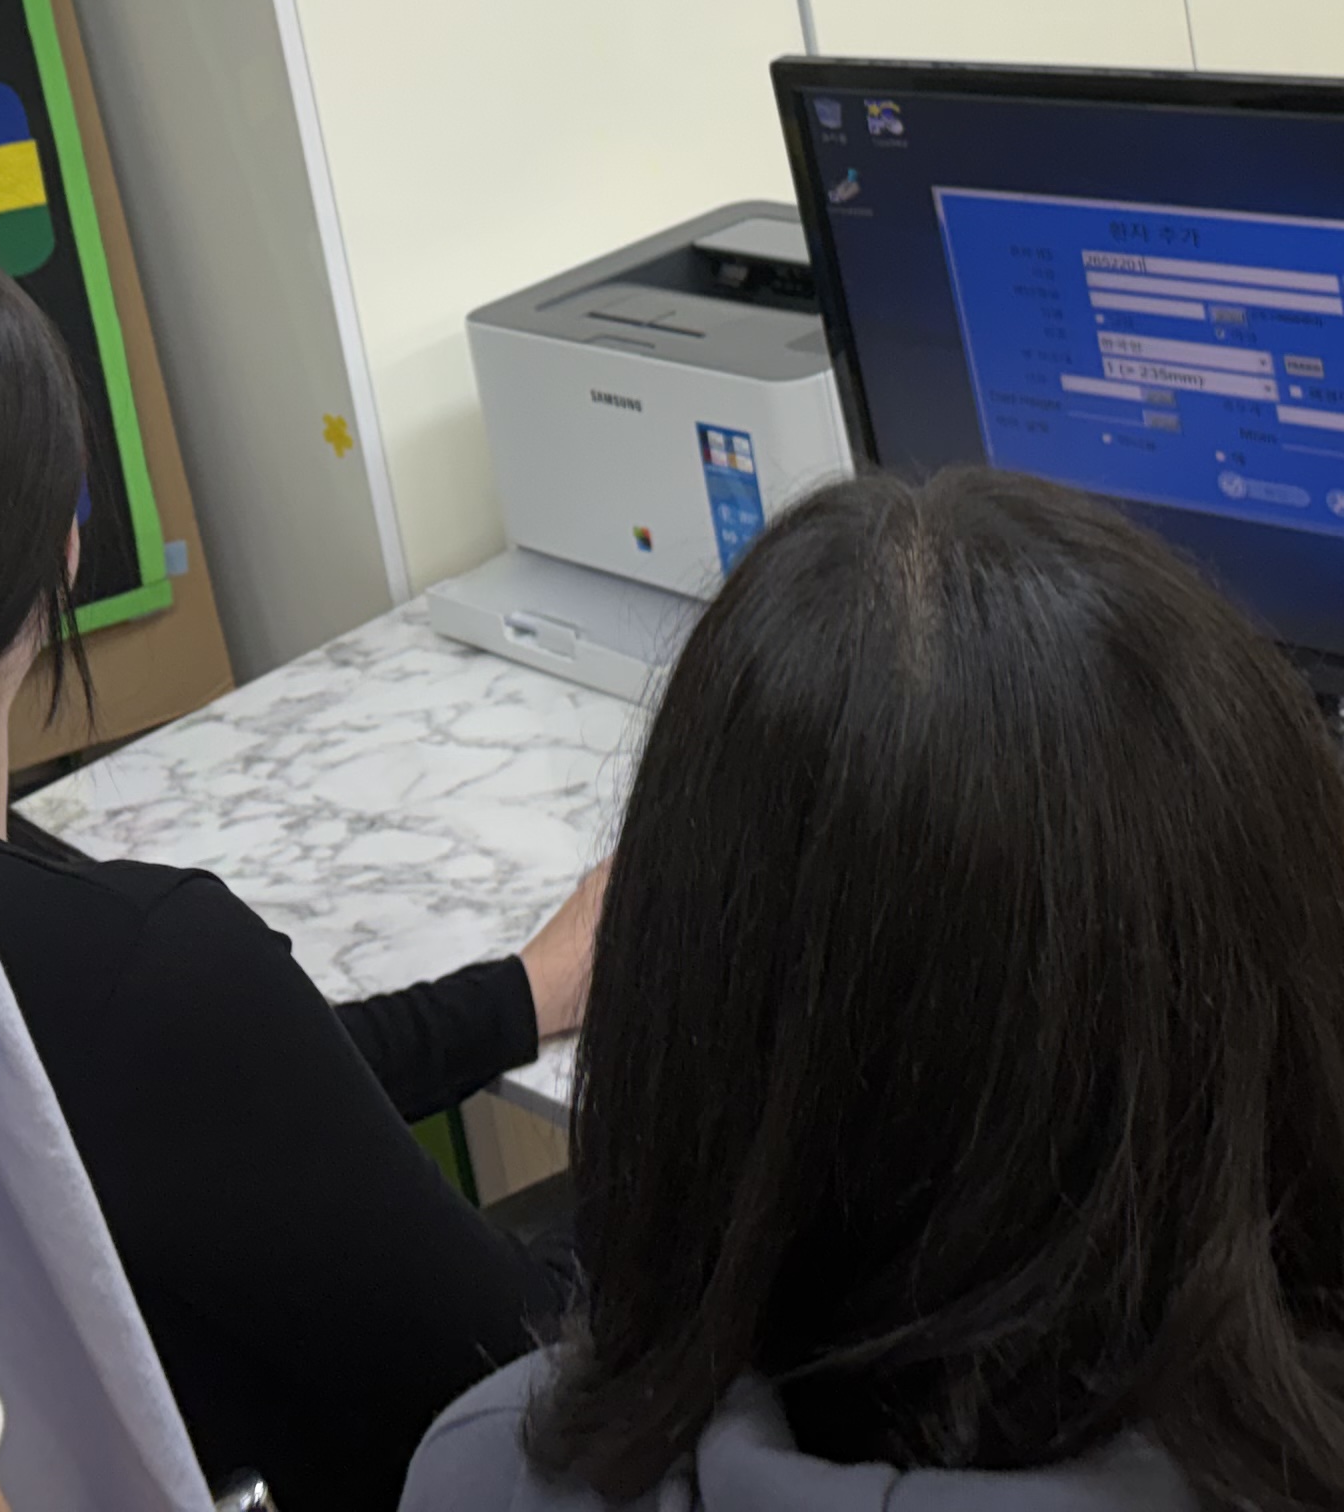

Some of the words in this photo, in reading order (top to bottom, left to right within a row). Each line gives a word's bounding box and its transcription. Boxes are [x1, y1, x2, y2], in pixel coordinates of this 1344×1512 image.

[1109, 220, 1150, 244] 환자
[1159, 225, 1200, 248] 추가
[590, 389, 642, 412] SAMSUNG
